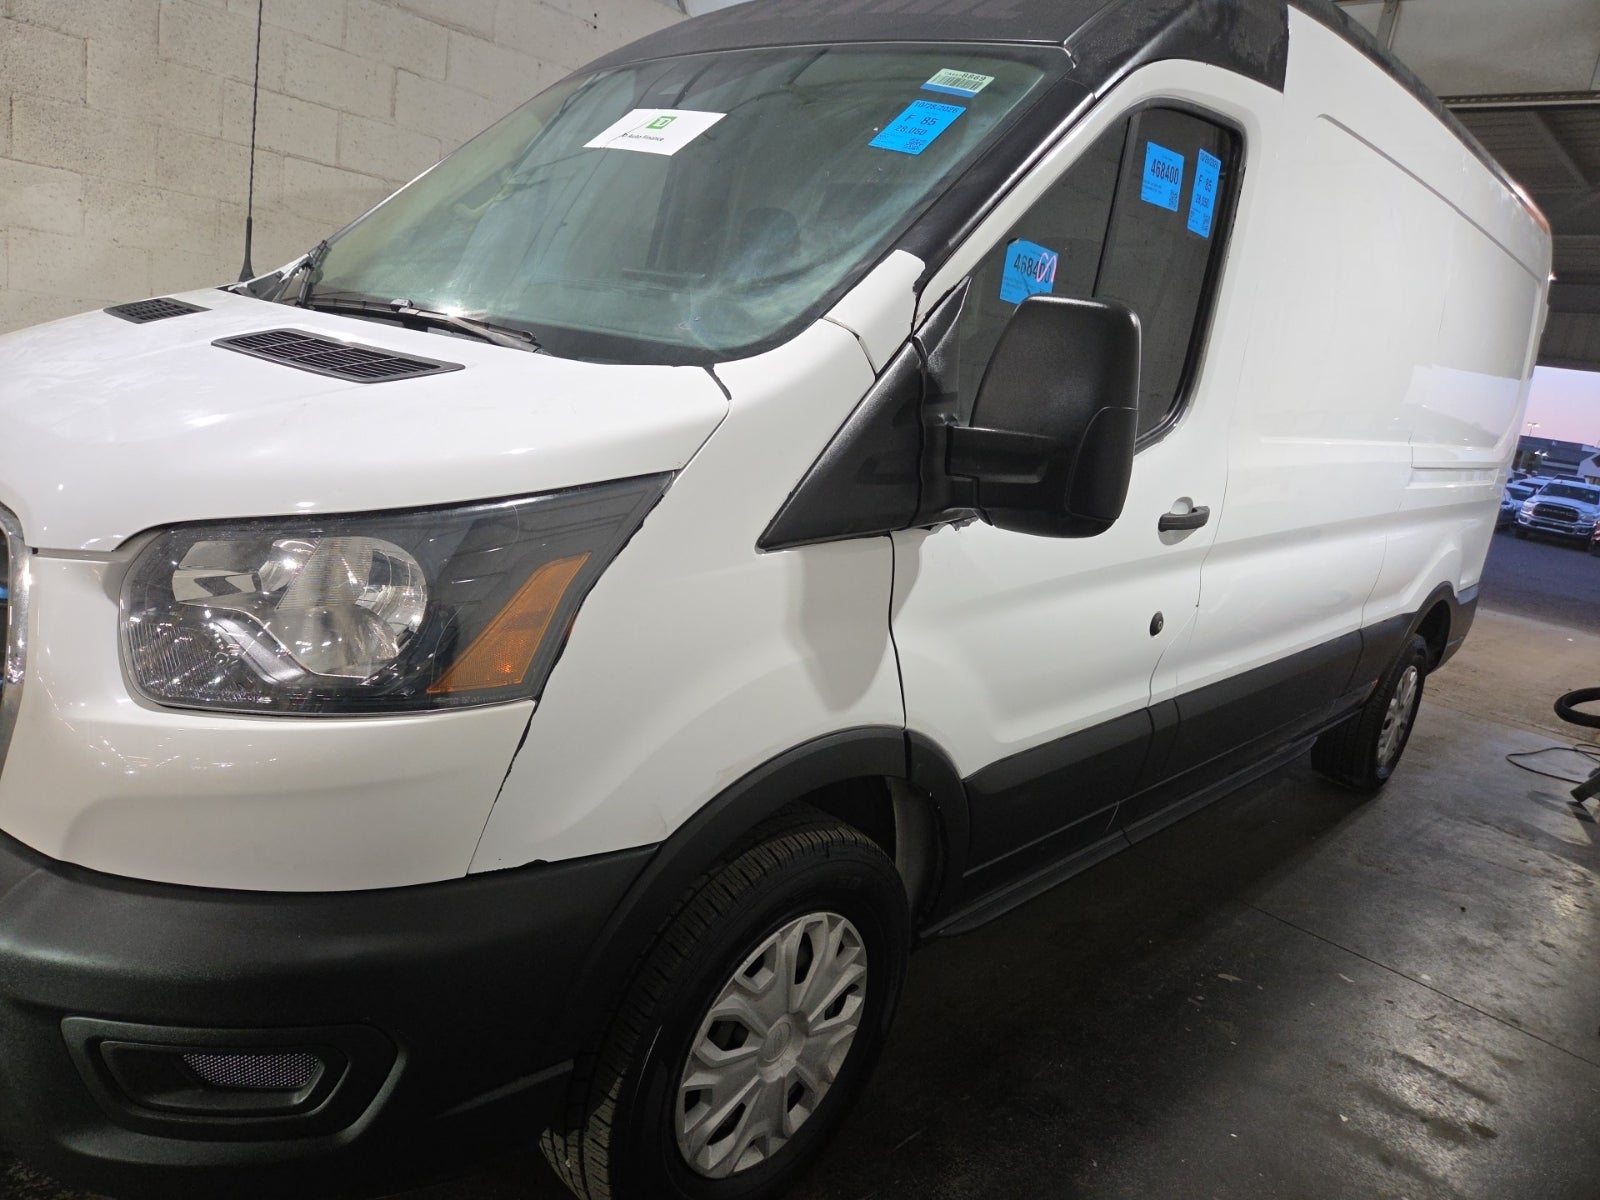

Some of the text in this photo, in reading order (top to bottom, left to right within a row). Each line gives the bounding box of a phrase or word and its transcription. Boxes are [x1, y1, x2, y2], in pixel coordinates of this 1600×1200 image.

[904, 114, 938, 126] F 85
[1151, 159, 1180, 185] 468400
